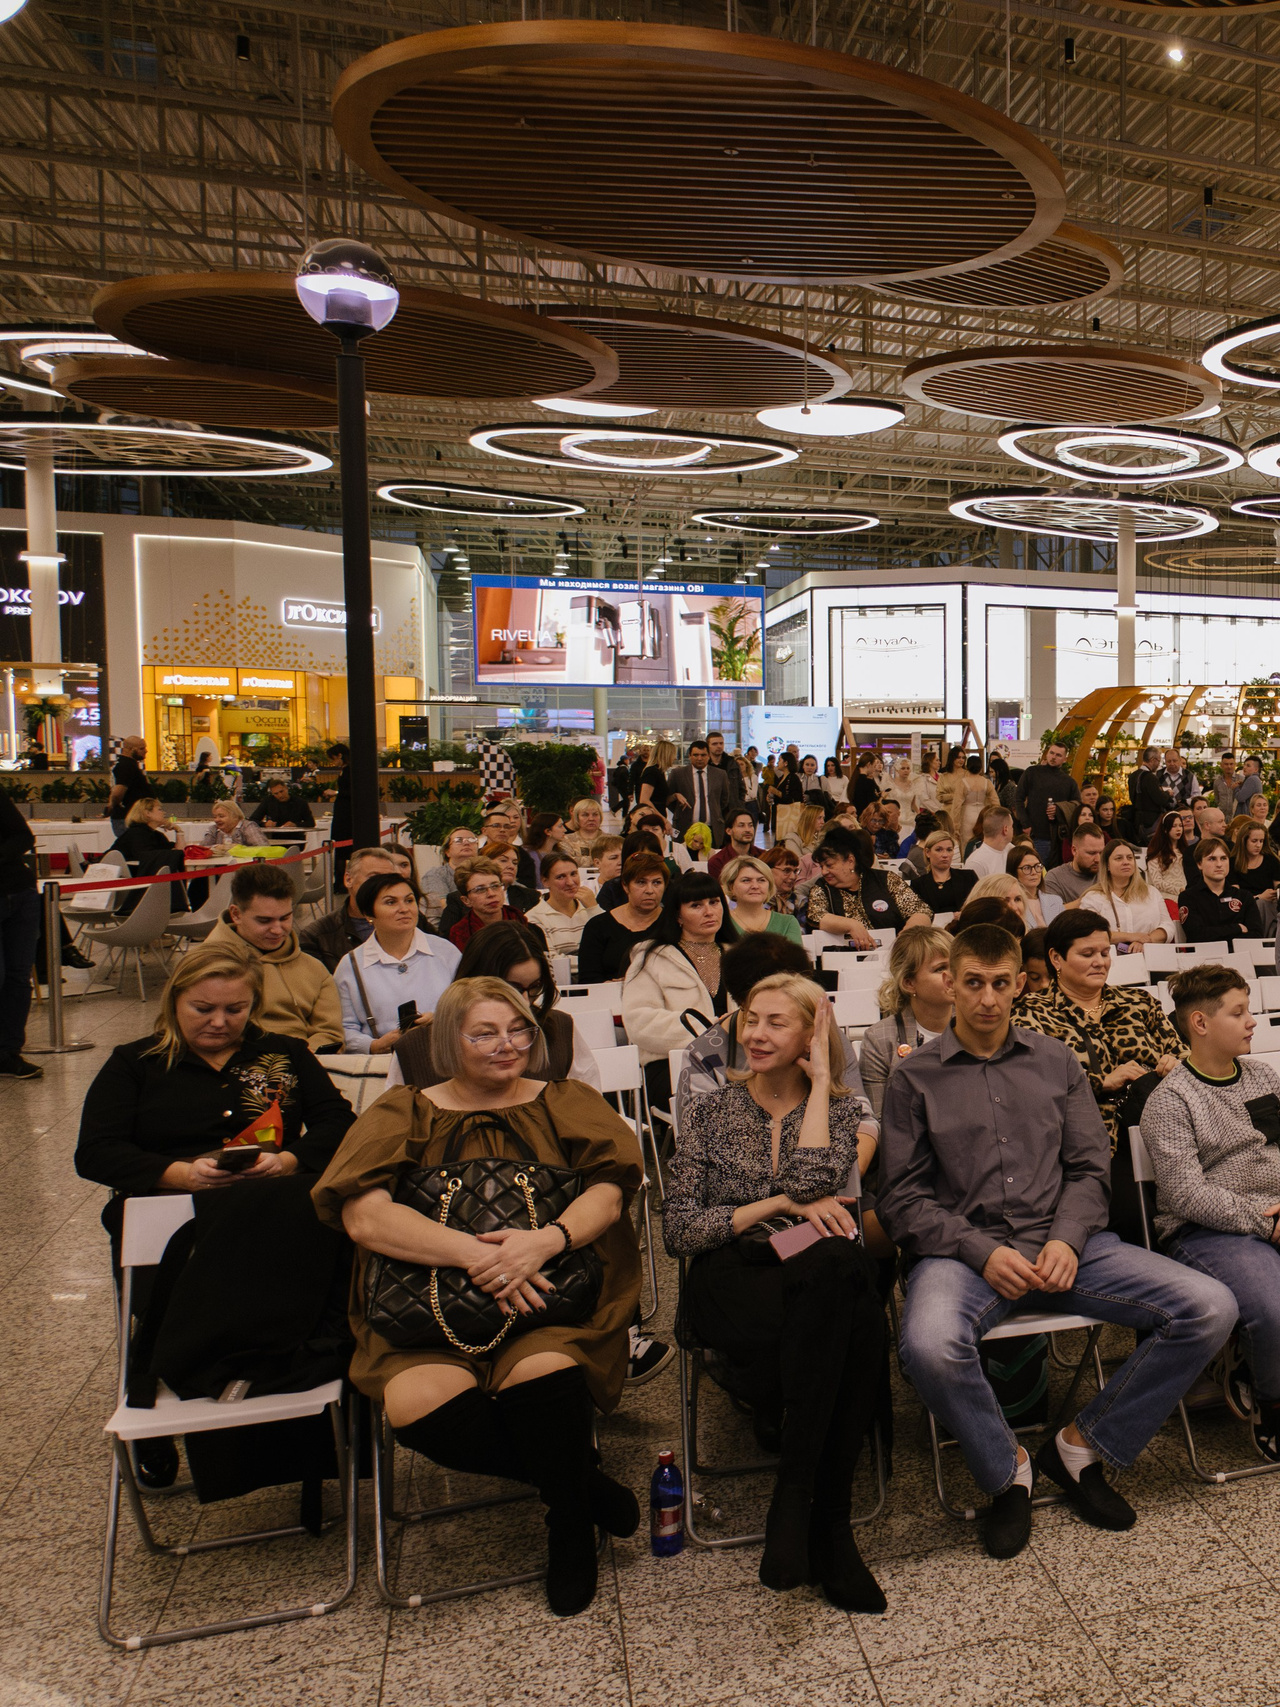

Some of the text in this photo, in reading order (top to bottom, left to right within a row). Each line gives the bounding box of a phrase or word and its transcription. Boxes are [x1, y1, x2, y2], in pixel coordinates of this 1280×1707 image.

[539, 578, 556, 587] Мы
[558, 581, 610, 590] находимся
[641, 584, 685, 592] магазина
[491, 628, 553, 642] RIVELIA
